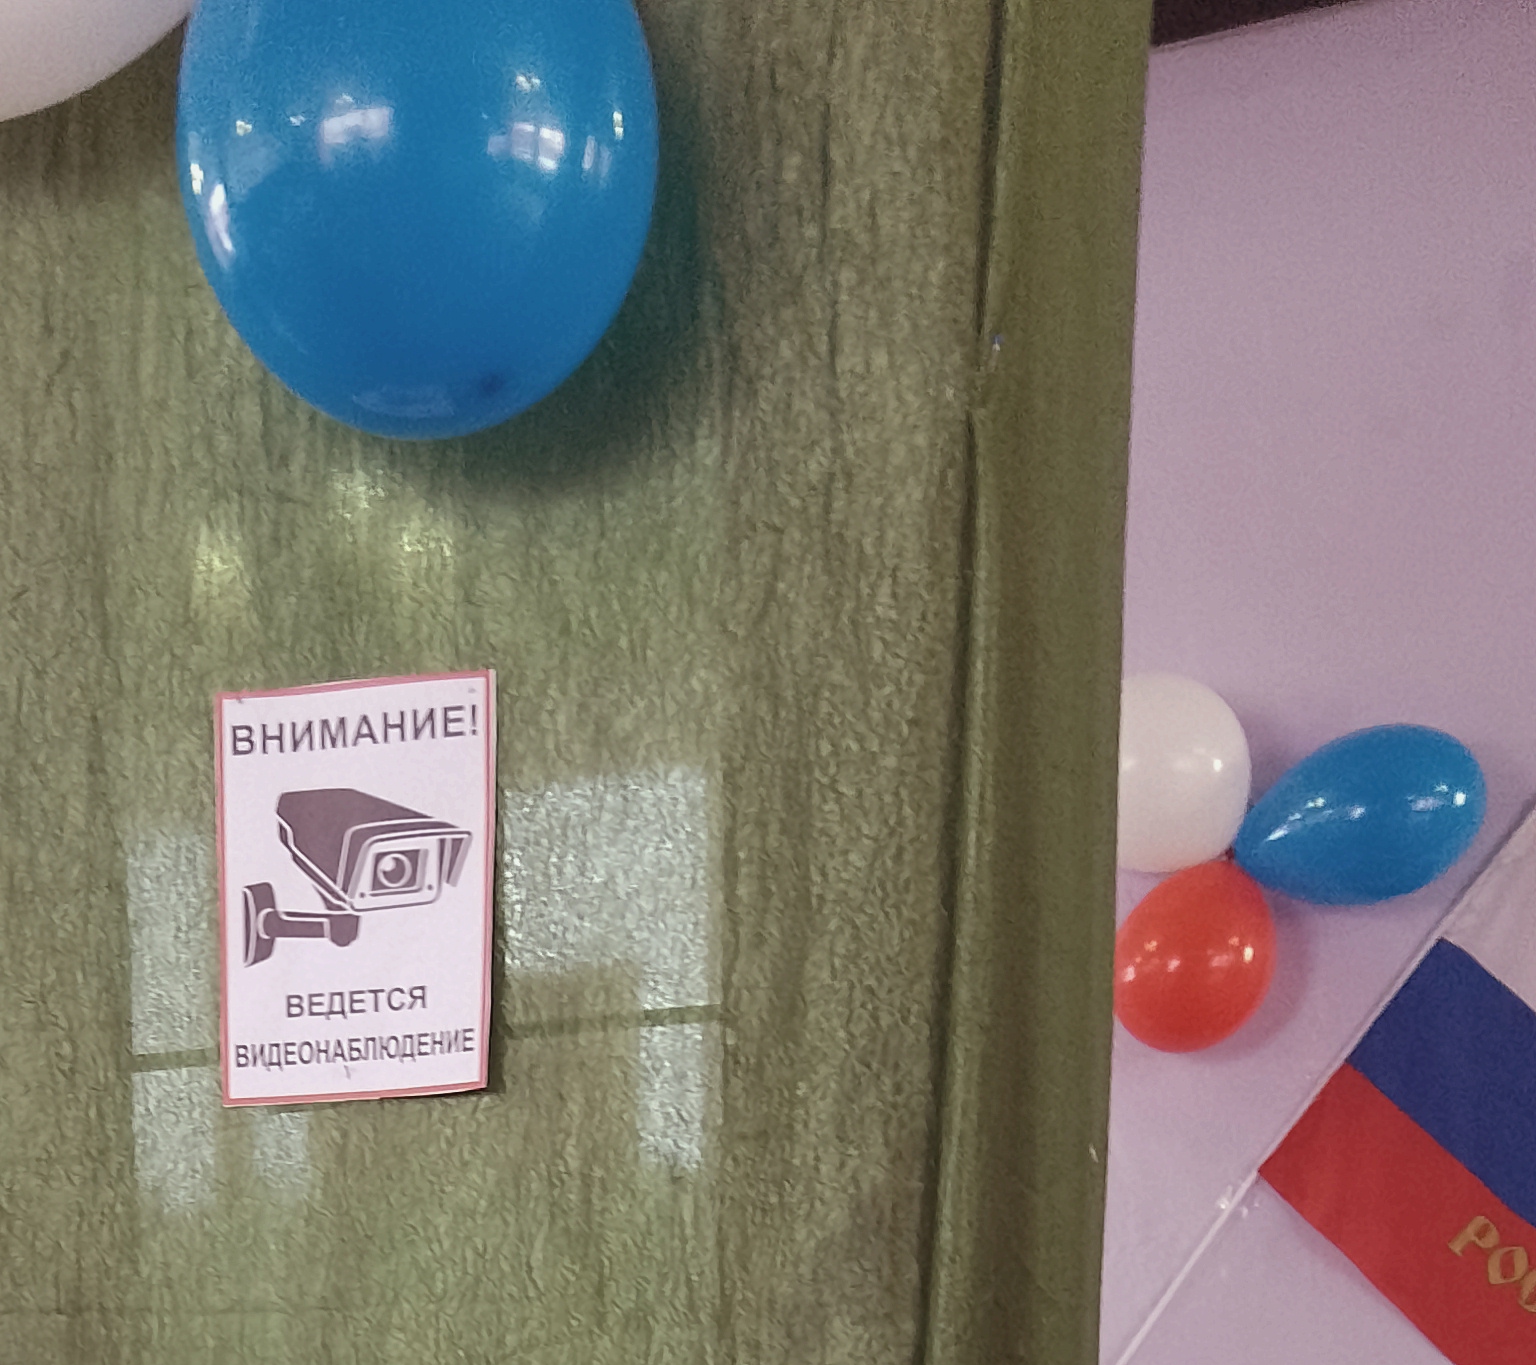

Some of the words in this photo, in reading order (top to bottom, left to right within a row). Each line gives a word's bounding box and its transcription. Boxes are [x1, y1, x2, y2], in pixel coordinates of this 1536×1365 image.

[231, 704, 478, 756] ВНИМАНИЕ!
[286, 985, 428, 1020] ВЕДЕТСЯ
[235, 1028, 476, 1071] ВИДЕОНАБЛЮДЕНИЕ
